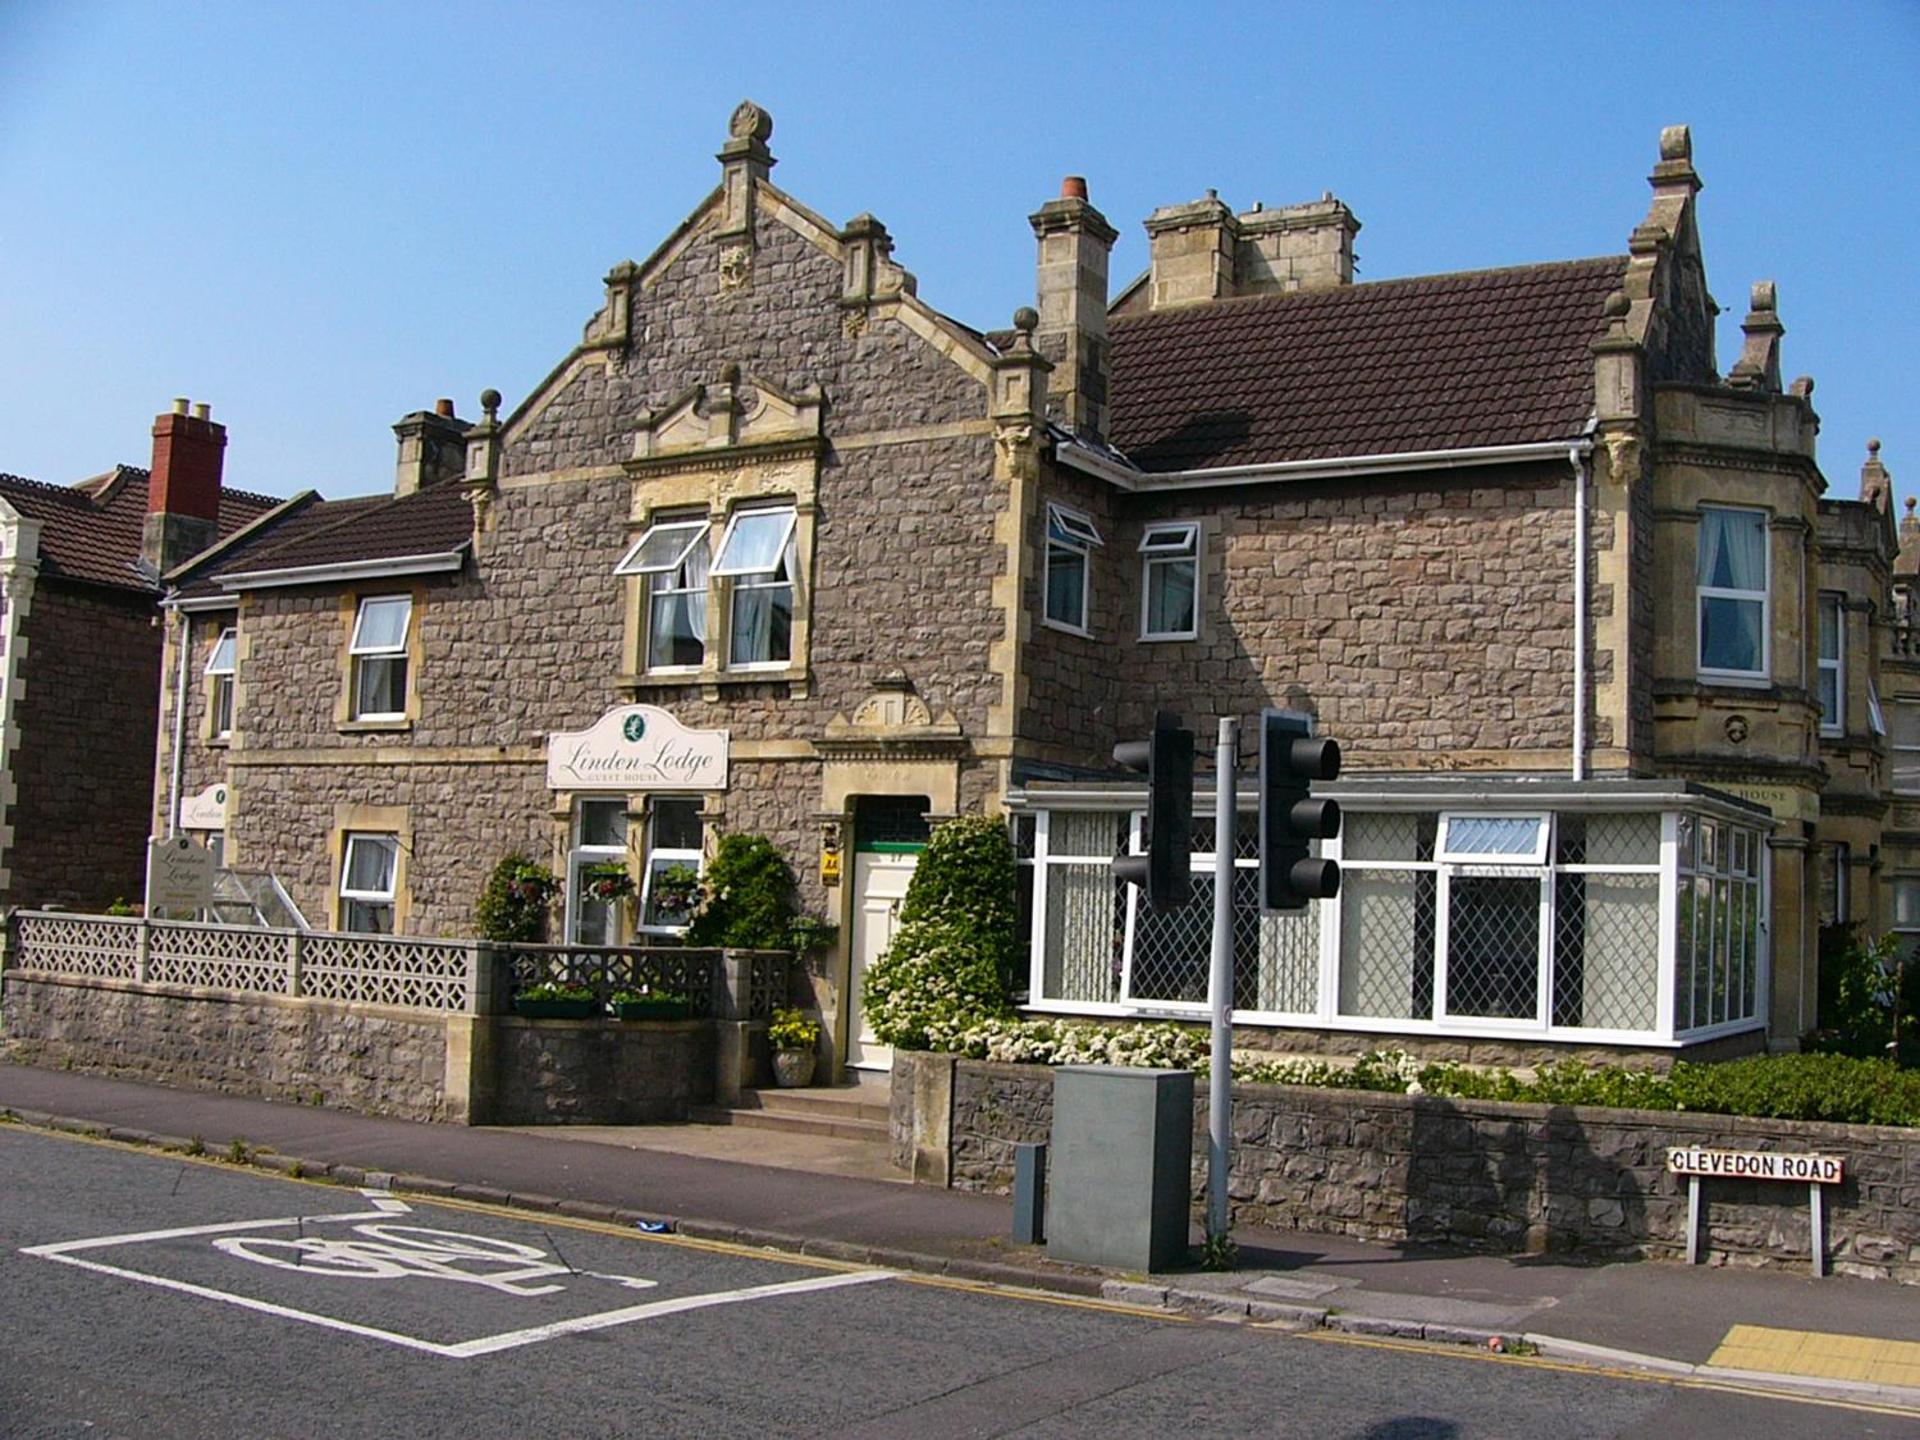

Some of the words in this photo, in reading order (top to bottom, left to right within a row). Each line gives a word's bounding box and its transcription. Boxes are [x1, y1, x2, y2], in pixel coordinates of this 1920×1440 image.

[561, 740, 640, 782] Linden
[644, 738, 714, 782] Lodge
[624, 773, 659, 782] HOUSE
[1672, 1151, 1774, 1176] CLEVEDON
[1782, 1157, 1836, 1180] ROAD
